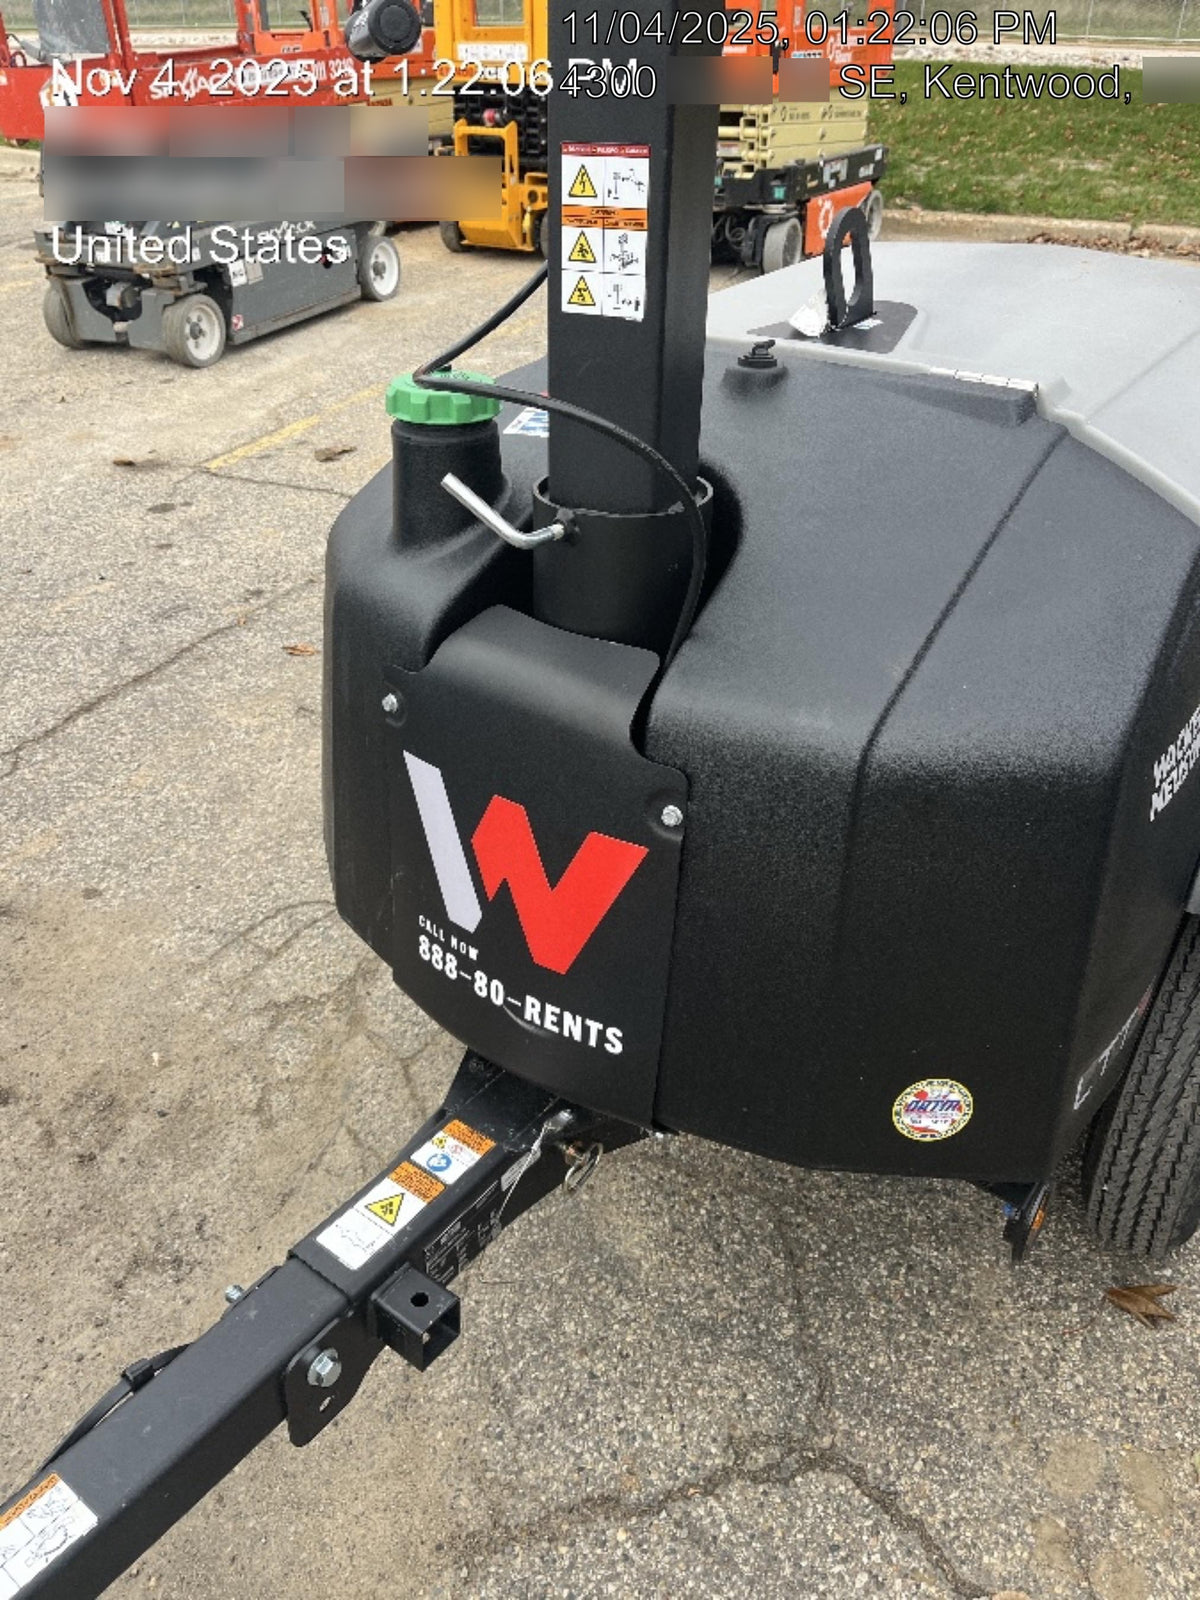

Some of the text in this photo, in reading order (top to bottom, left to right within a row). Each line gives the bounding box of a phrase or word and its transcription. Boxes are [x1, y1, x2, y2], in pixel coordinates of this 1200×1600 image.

[419, 914, 479, 961] CALL NOW
[418, 934, 623, 1055] 888-80-RENTS
